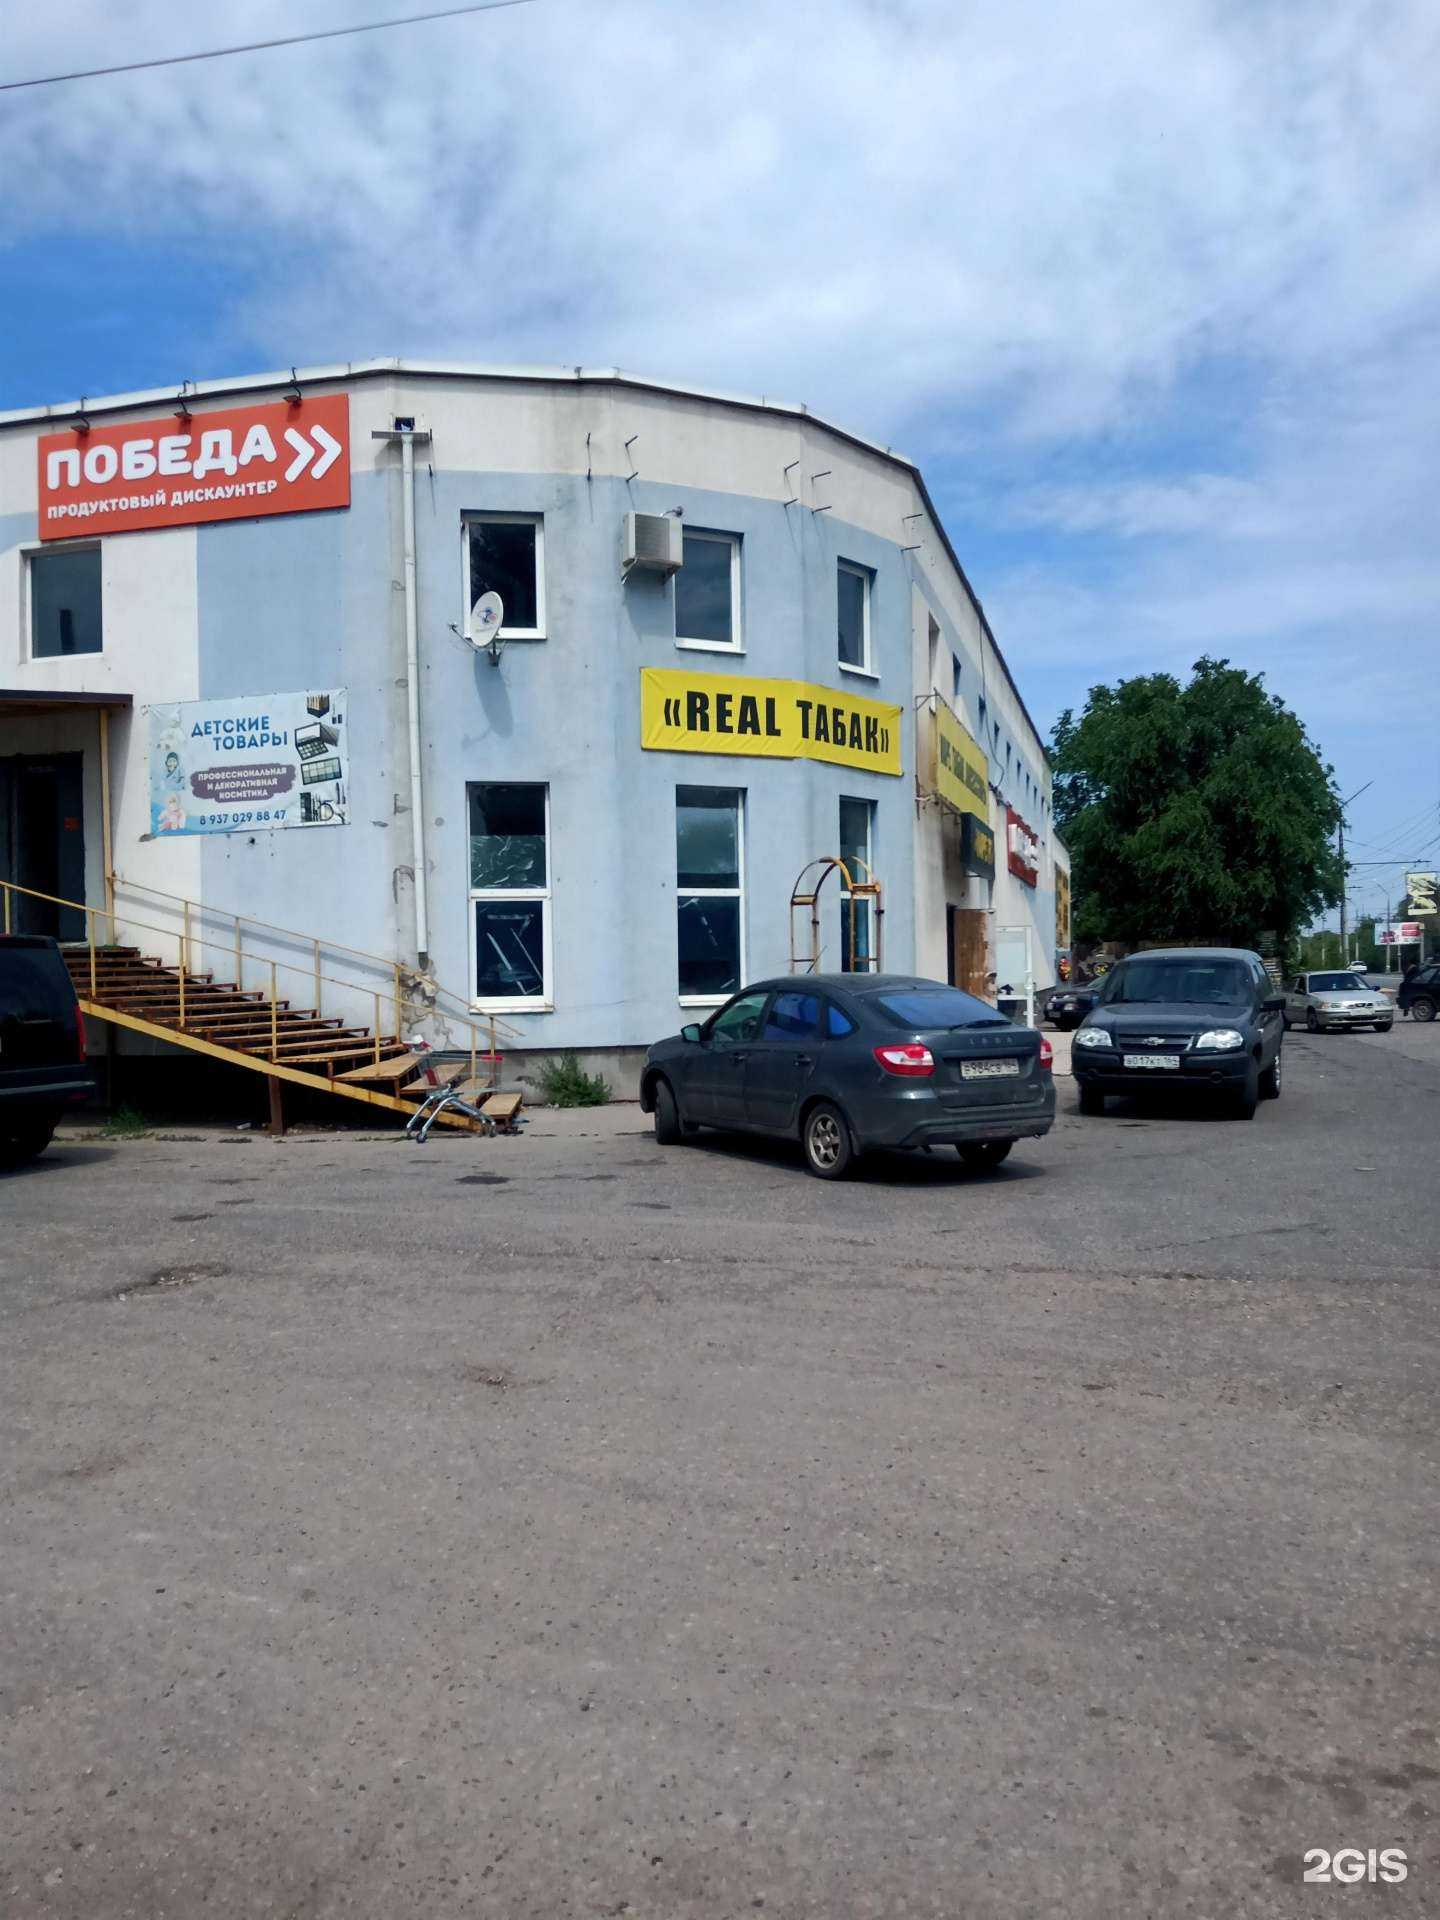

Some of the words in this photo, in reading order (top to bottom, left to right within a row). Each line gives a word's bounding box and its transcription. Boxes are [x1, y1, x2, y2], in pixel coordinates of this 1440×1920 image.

[46, 424, 278, 490] ПОБЕДА
[47, 491, 166, 519] ПРОДУКТОВЫЙ
[171, 480, 278, 507] ДИСКАУНТЕР
[191, 715, 270, 738] ДЕТСКИЕ
[664, 691, 781, 736] «REAL
[796, 700, 889, 754] ТАБАК»
[213, 732, 288, 751] ТОВАРЫ
[198, 767, 287, 781] ПРОФЕССИОНАЛЬНАЯ
[207, 782, 213, 790] И
[215, 778, 278, 790] ДЕКОРАТИВНАЯ
[219, 789, 269, 800] КОСМЕТИКА
[199, 816, 205, 825] 8
[209, 813, 229, 825] 937
[232, 811, 252, 823] 029
[256, 810, 270, 821] 88
[274, 809, 287, 820] 47
